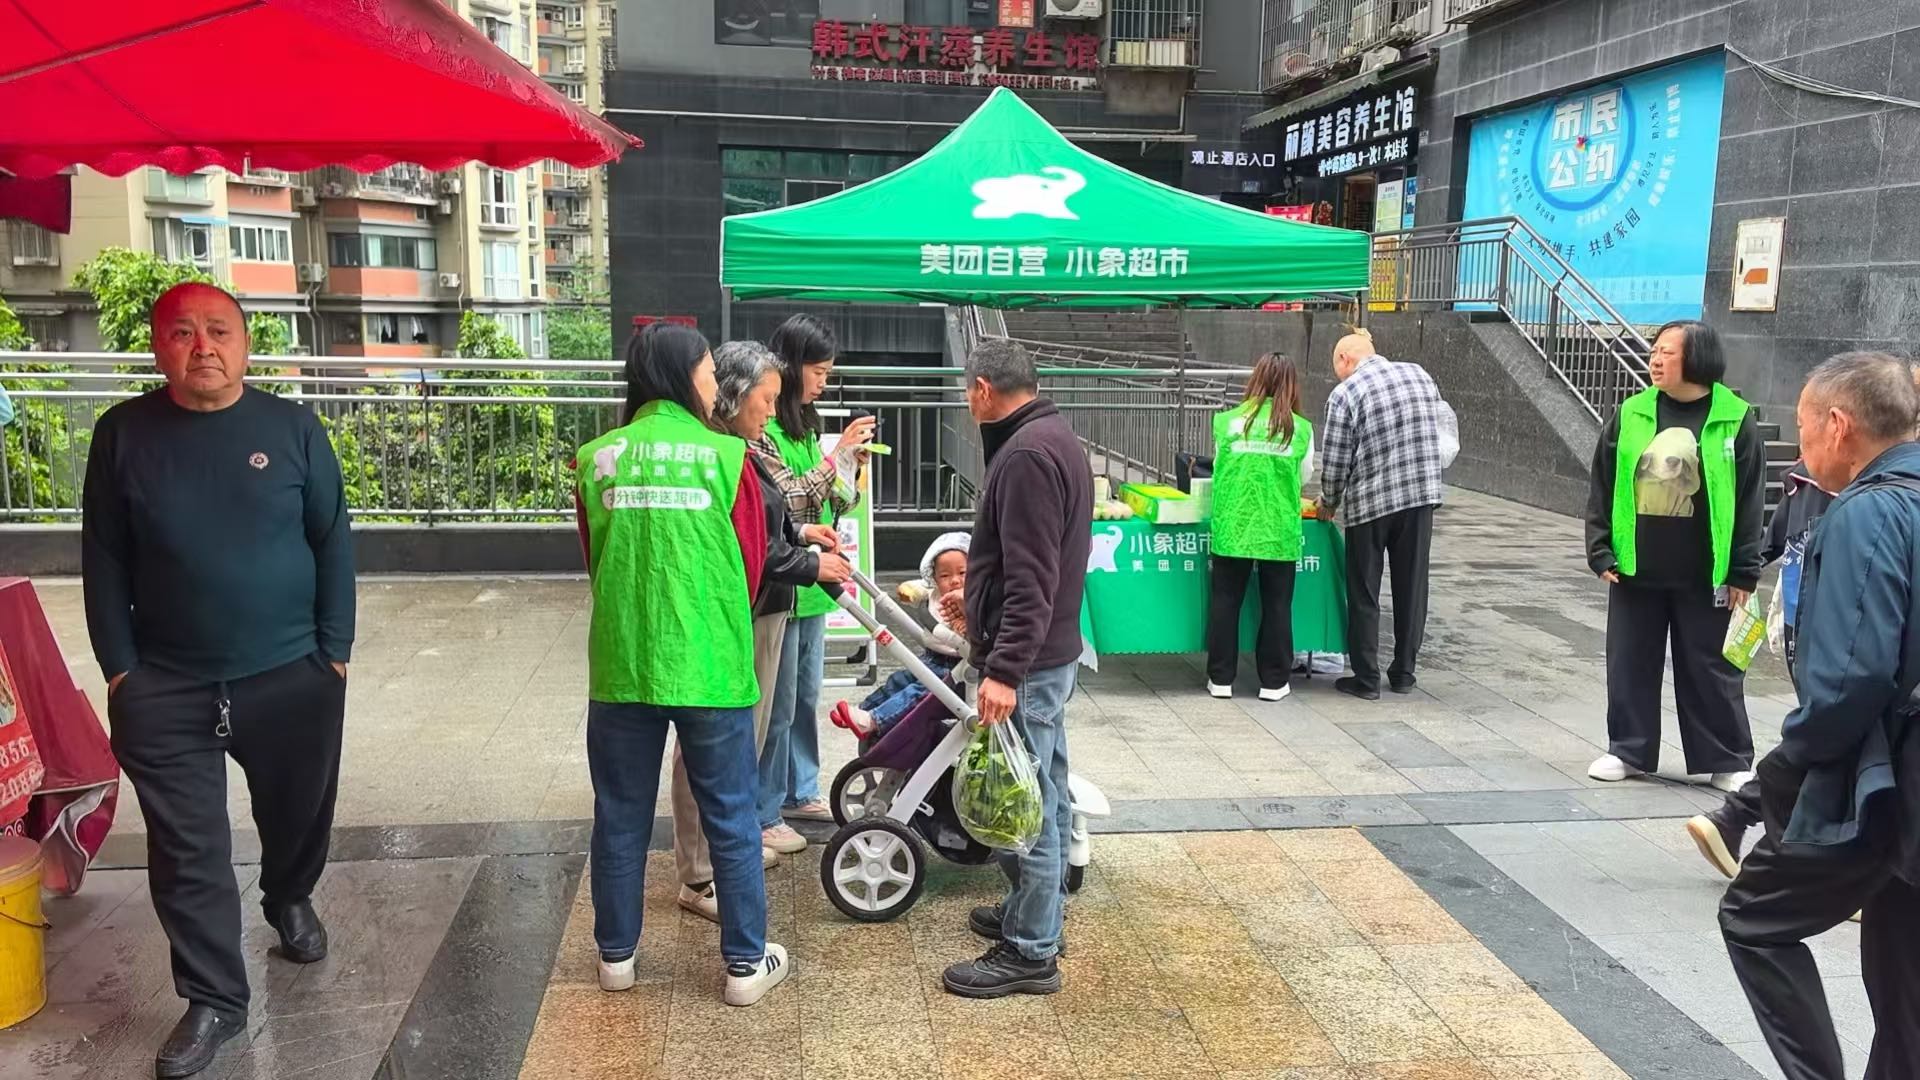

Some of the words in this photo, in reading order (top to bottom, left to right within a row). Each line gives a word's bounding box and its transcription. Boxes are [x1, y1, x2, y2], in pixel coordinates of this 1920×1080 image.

[813, 20, 1099, 71] 韩式汗蒸养生馆
[1284, 86, 1415, 162] 丽颜美容养生馆
[1552, 90, 1617, 142] 市民
[1191, 150, 1276, 167] 观止酒店入口
[1549, 143, 1616, 190] 公约
[1588, 207, 1641, 257] 共建家园
[920, 243, 1049, 276] 美团自营
[1065, 246, 1190, 278] 小象超市
[631, 441, 719, 465] 小象超市
[1132, 559, 1214, 573] 美团自
